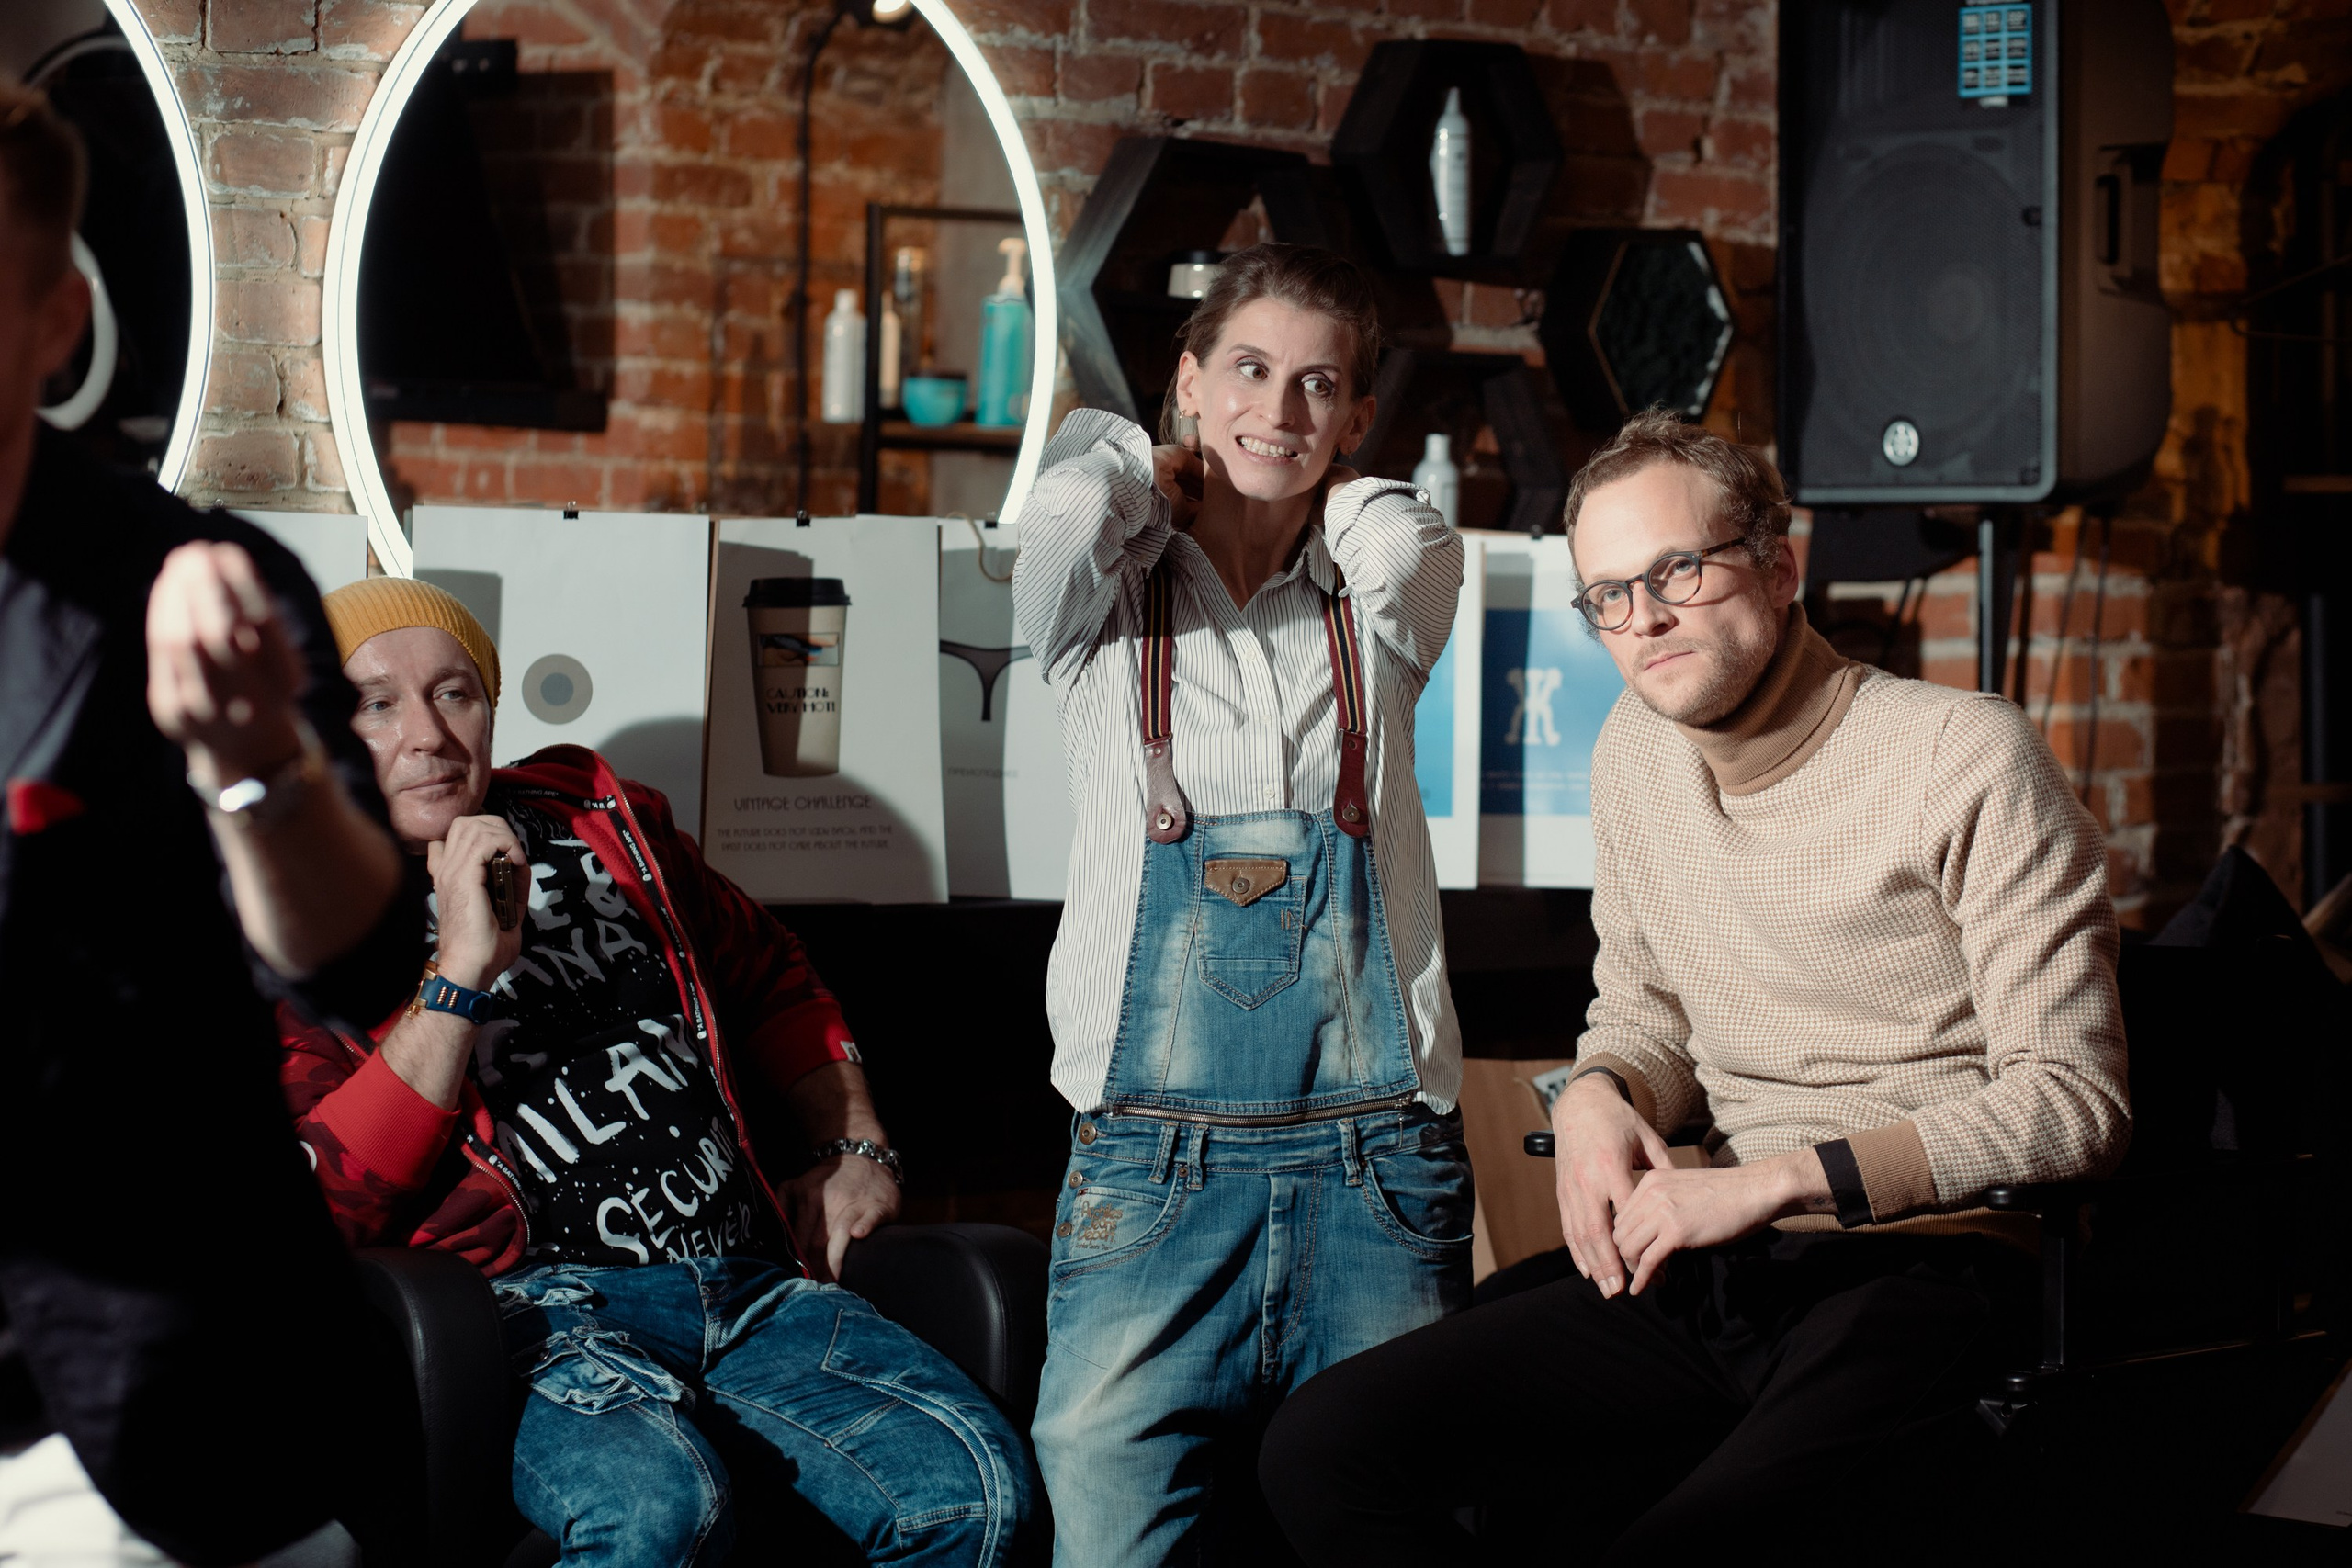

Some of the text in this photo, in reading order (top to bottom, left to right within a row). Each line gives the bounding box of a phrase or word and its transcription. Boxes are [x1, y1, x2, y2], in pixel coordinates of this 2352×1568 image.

[733, 794, 873, 812] VINTAGE CHALLENGE
[718, 828, 730, 838] THE
[763, 827, 787, 837] DOES
[789, 827, 807, 837] NOT
[743, 841, 767, 852] DOES
[769, 841, 786, 851] NOT
